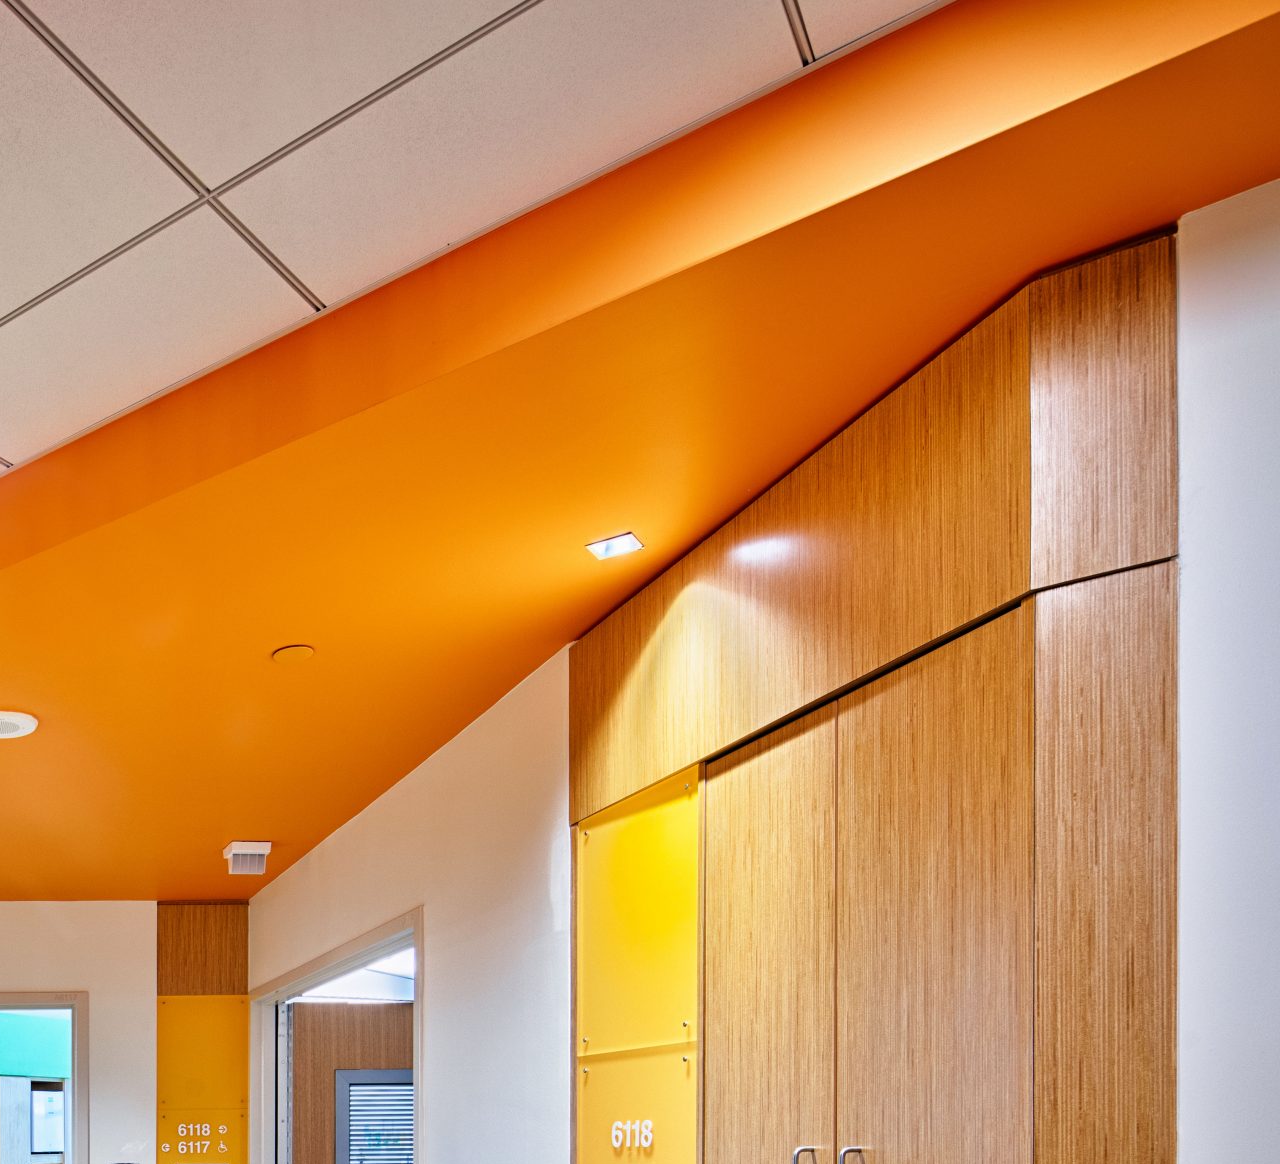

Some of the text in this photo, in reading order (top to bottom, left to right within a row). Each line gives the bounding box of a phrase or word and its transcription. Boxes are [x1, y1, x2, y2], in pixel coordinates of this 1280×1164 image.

[178, 1124, 210, 1136] 6118
[611, 1120, 653, 1148] 6118
[178, 1141, 210, 1153] 6117
